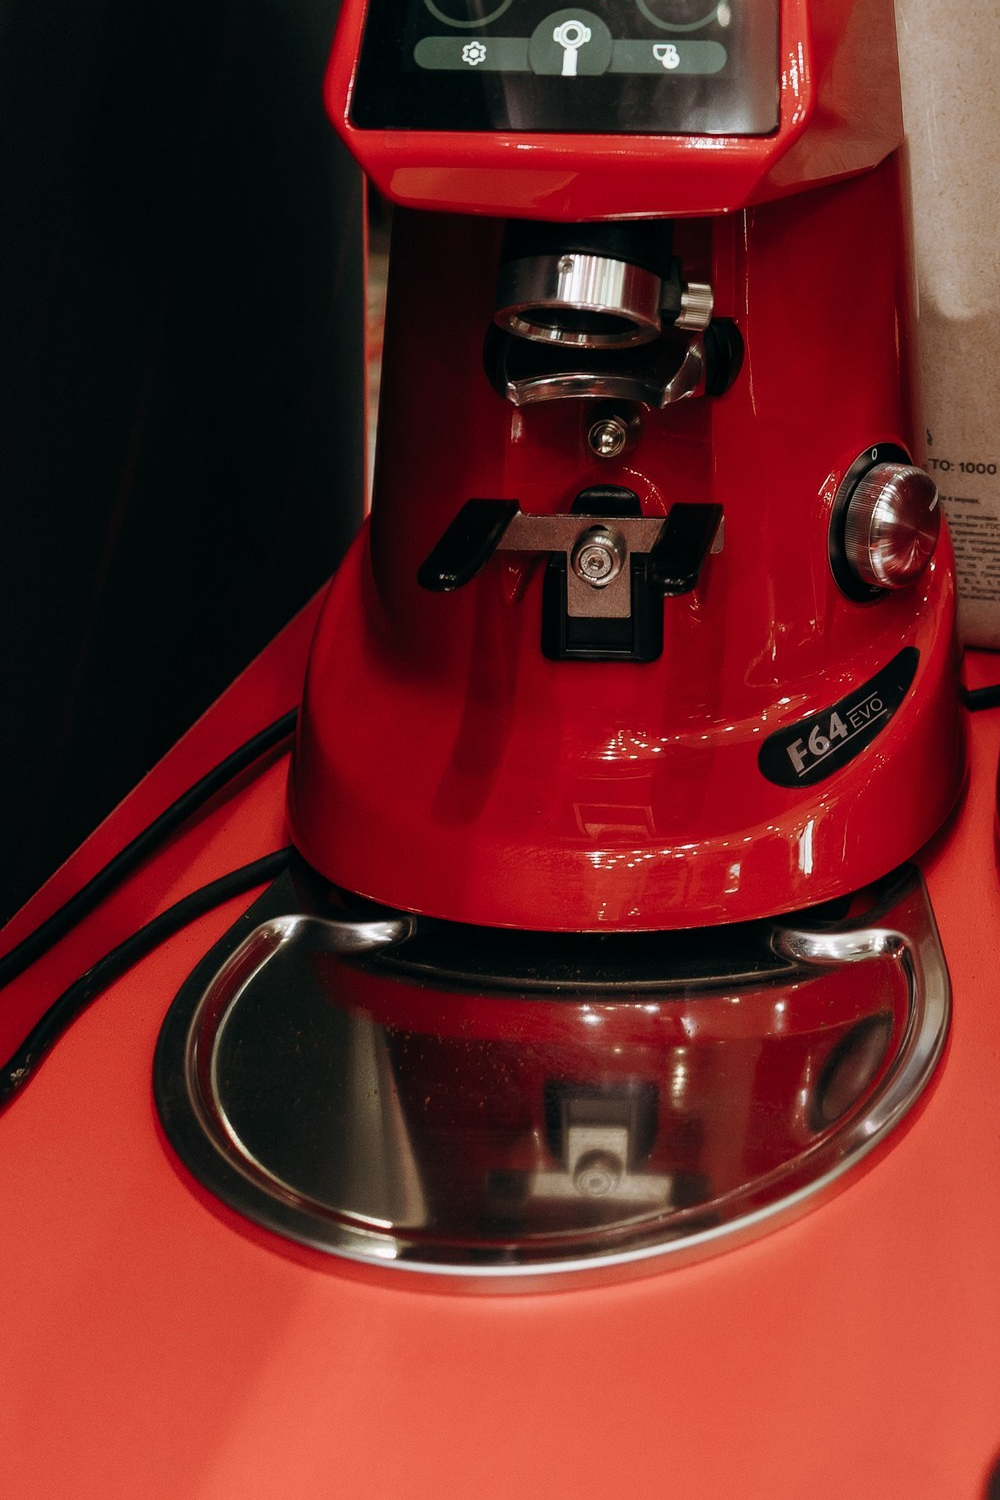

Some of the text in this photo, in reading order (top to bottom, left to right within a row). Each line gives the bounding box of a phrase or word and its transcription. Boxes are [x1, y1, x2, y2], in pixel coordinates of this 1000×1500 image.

[959, 462, 997, 475] 1000
[786, 697, 883, 774] F64 EVO
